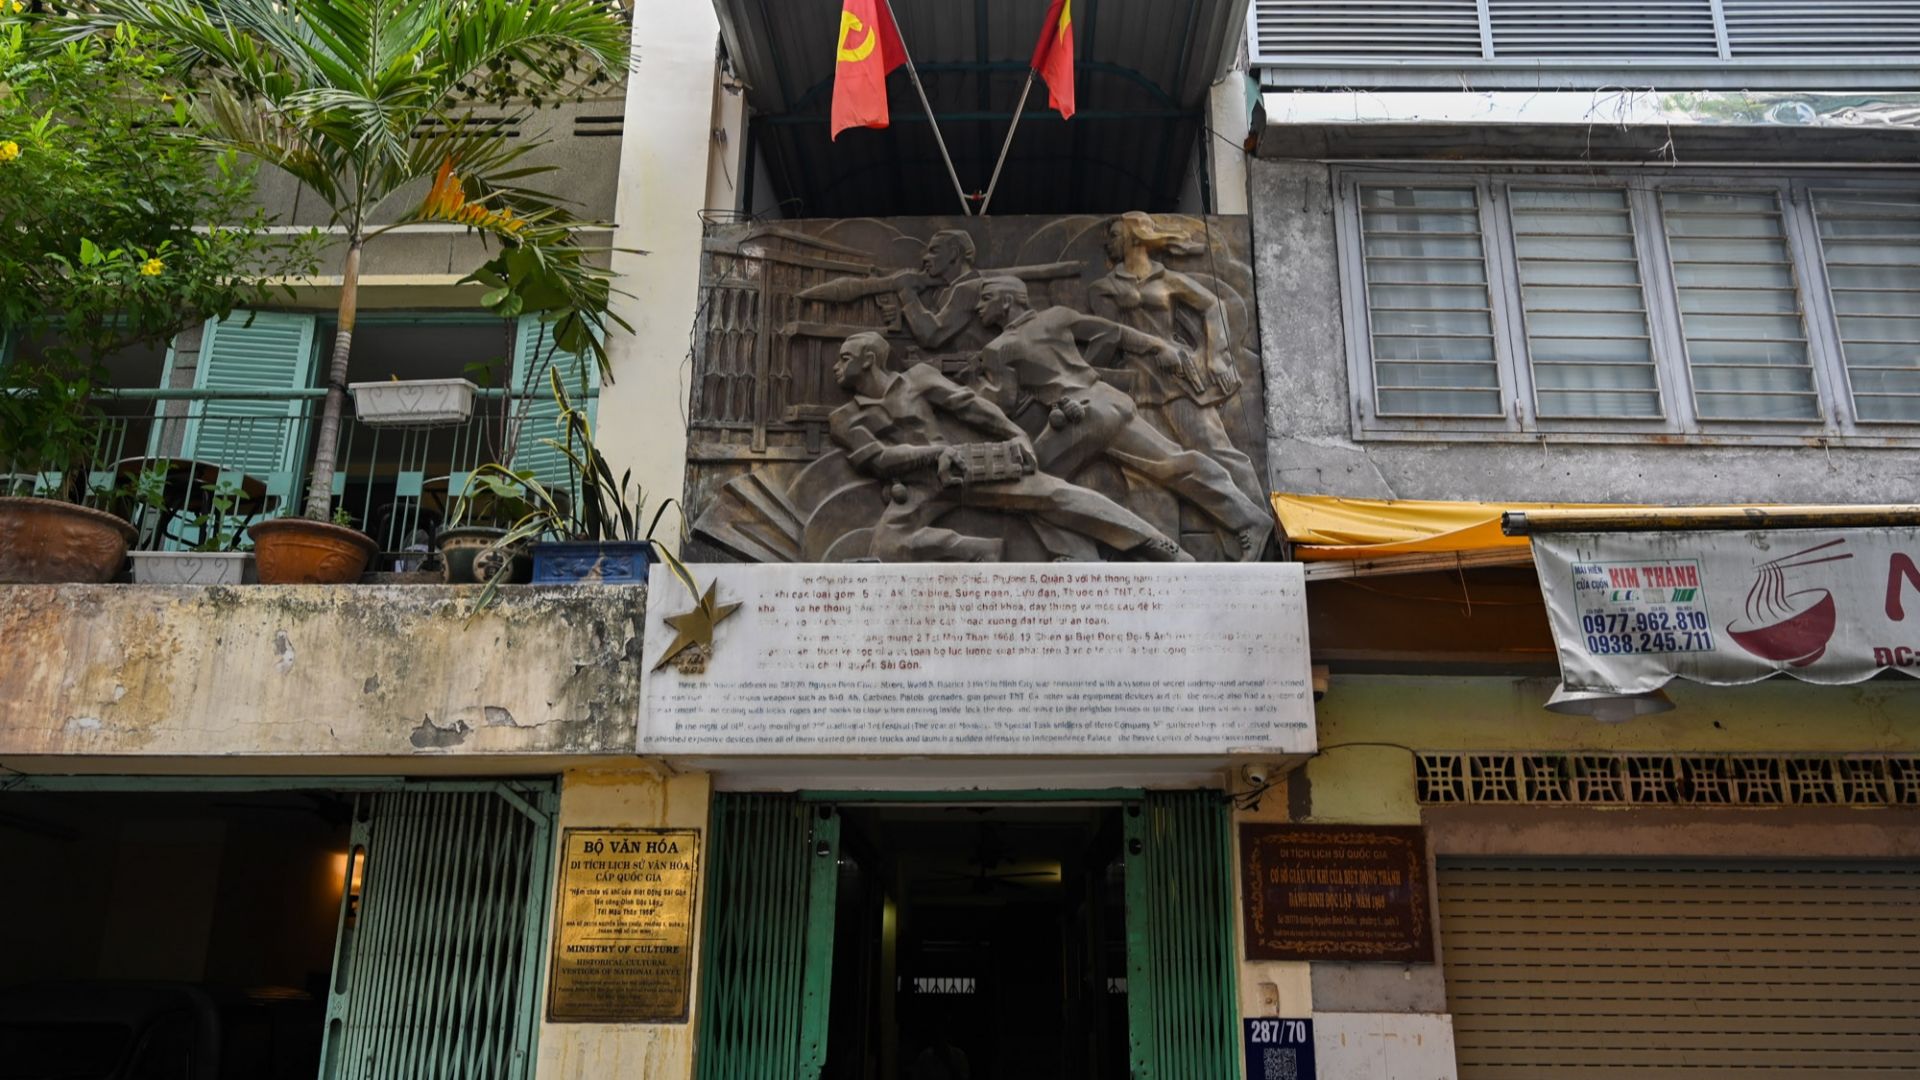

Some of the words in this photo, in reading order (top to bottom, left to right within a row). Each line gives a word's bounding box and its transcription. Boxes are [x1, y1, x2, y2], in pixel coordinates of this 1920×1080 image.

[1067, 575, 1074, 584] 3
[1608, 567, 1641, 589] KIM
[1582, 611, 1707, 635] 0977.962.810
[1587, 632, 1712, 656] 0938.245.711
[583, 837, 604, 857] BỘ
[609, 837, 642, 854] VĂN
[646, 837, 679, 854] HÓA
[1279, 849, 1290, 859] DI
[570, 860, 581, 871] DI
[566, 944, 615, 954] MINISTRY
[617, 944, 632, 953] OF
[633, 944, 680, 954] CULTURE
[576, 958, 624, 967] HISTORICAL
[561, 968, 600, 977] VESTIGES
[600, 968, 612, 976] OF
[614, 967, 653, 977] NATIONAL
[655, 968, 681, 977] LEVEL
[1250, 1020, 1307, 1045] 287/70
